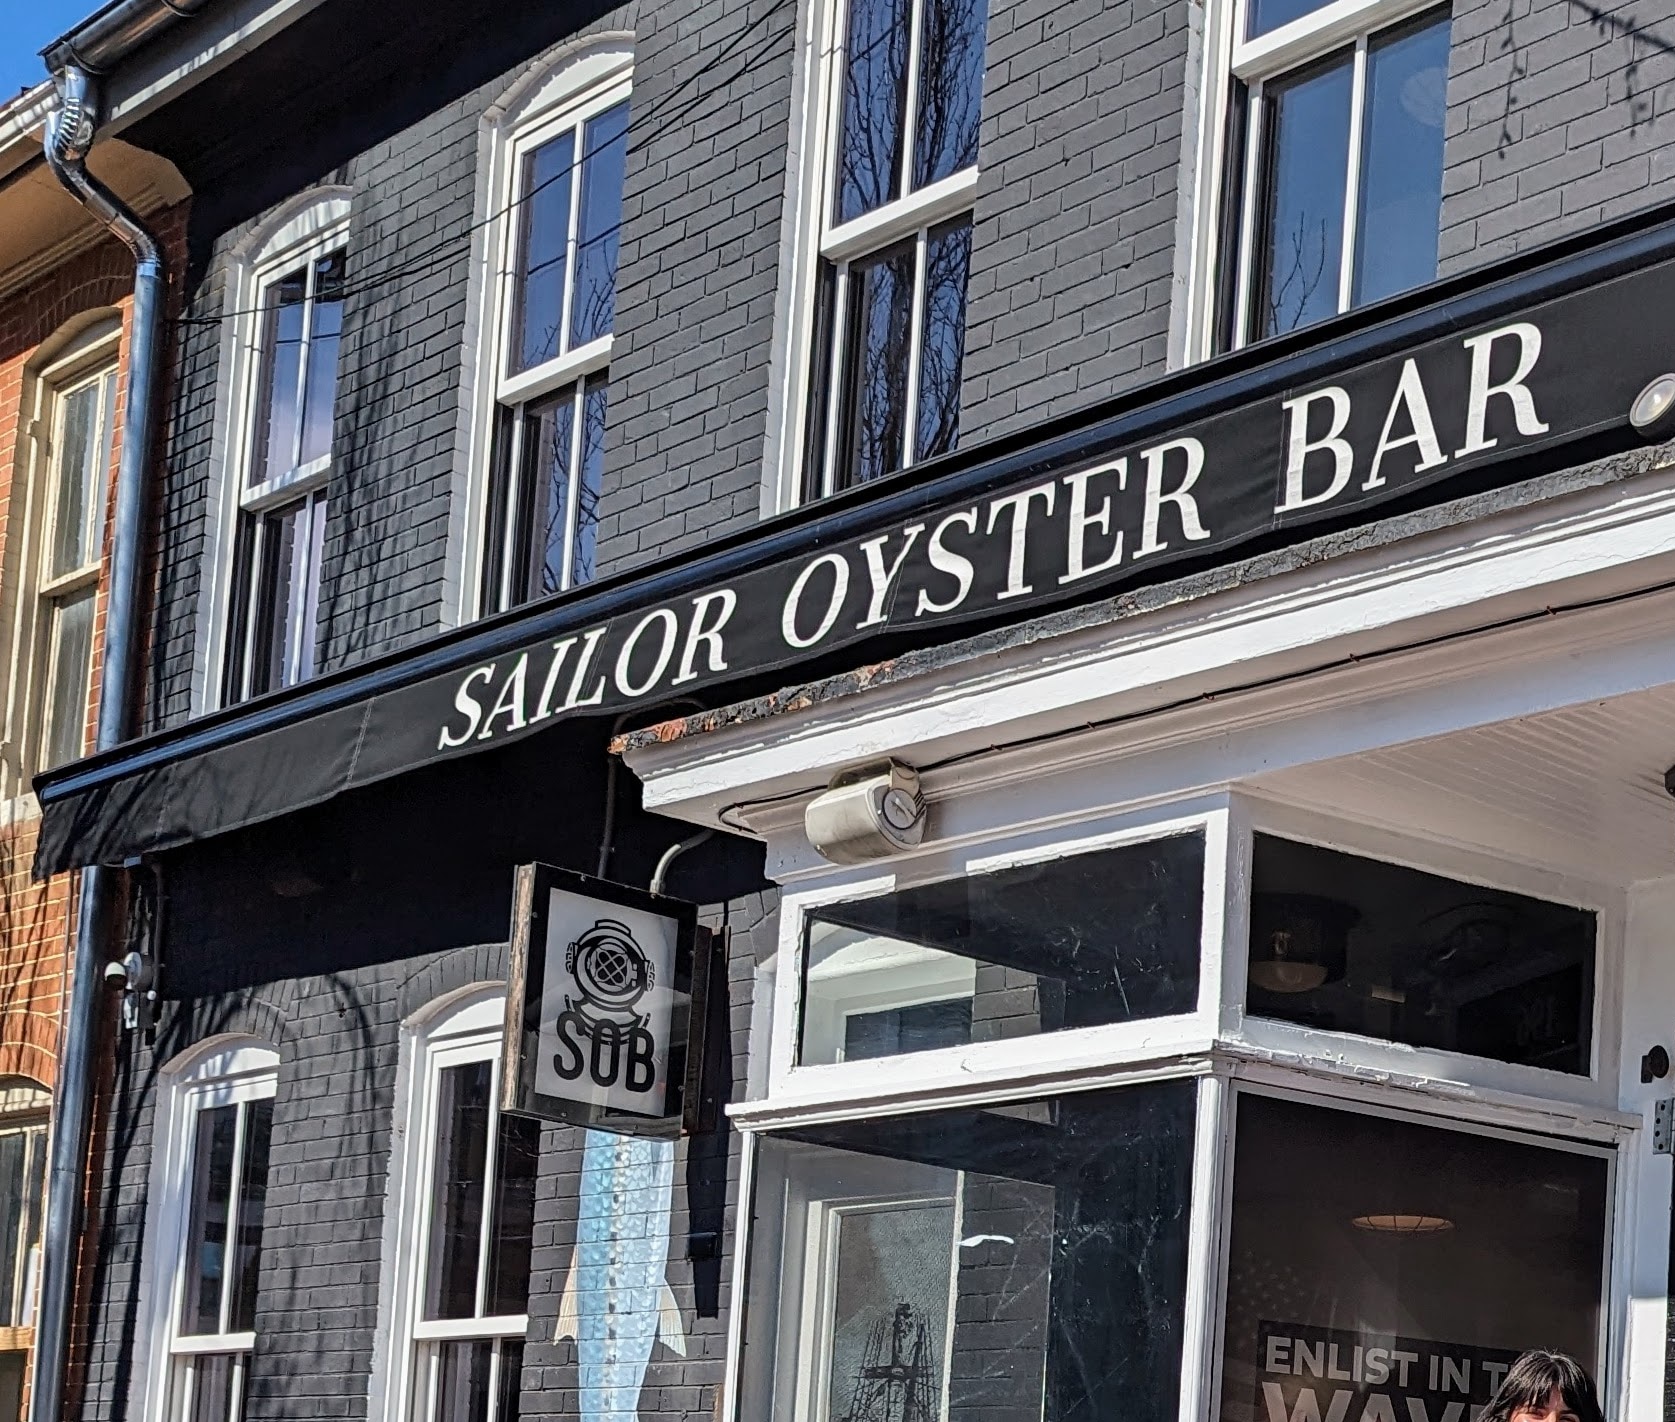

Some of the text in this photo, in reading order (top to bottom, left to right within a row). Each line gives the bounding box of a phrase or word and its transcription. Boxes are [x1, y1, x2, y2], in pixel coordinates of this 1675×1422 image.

[437, 320, 1549, 752] SAILOR OYSTER BAR
[553, 1010, 656, 1093] SOB
[1265, 1335, 1418, 1387] ENLIST
[1428, 1355, 1471, 1394] IN
